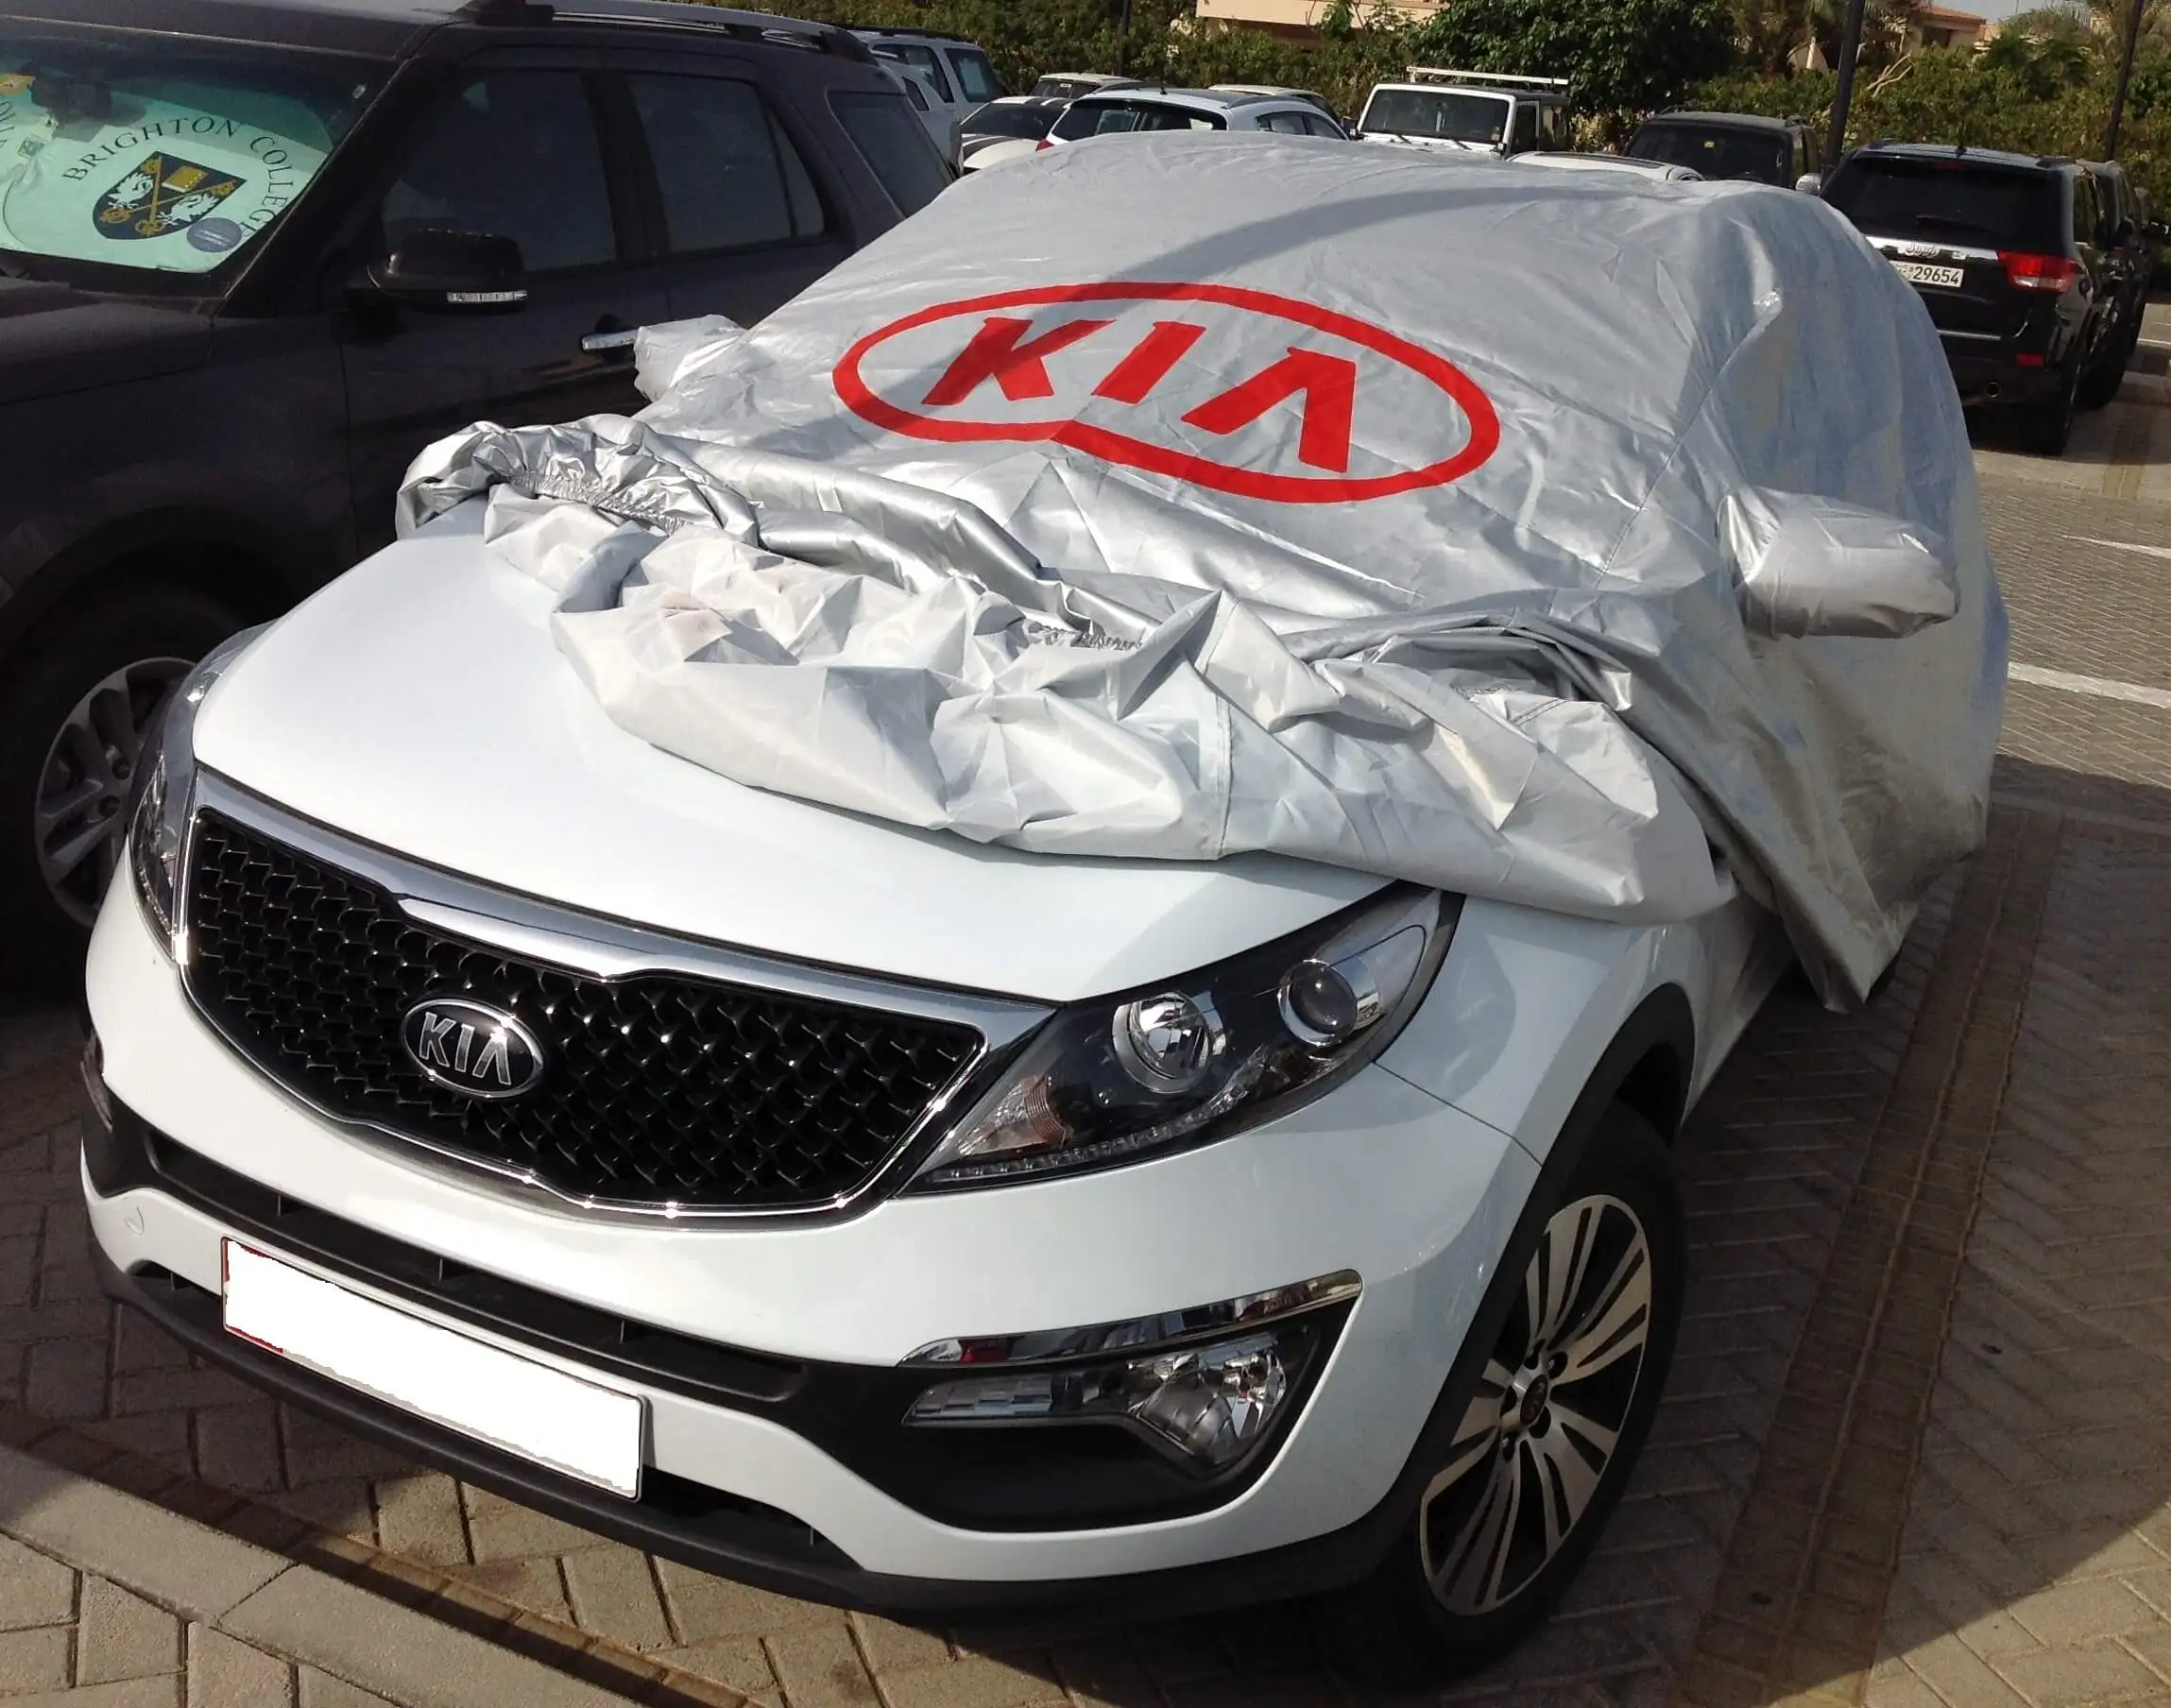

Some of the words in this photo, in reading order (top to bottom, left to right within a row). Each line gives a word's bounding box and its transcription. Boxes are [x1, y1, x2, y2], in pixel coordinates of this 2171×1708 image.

[62, 115, 240, 181] BRIGHTON
[1913, 265, 1959, 284] 29654
[921, 316, 1357, 473] KIA
[419, 1011, 512, 1085] KIA
